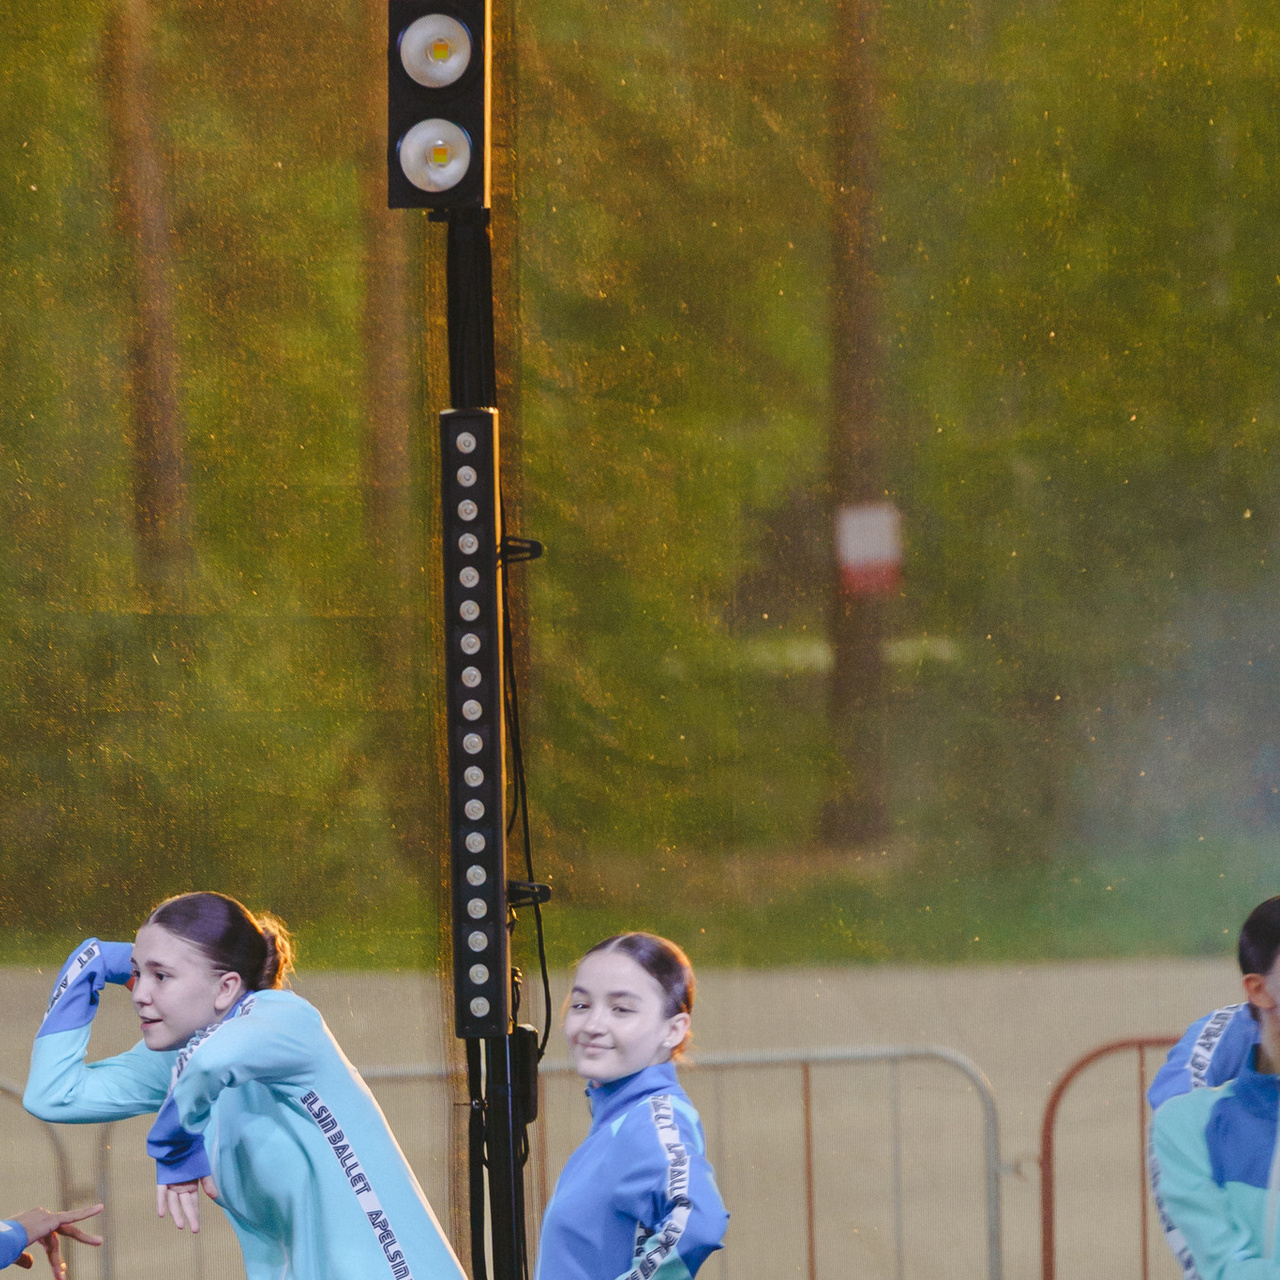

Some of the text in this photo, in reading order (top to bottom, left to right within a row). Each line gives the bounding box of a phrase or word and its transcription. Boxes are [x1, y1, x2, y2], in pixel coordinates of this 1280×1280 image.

[300, 1091, 338, 1134] ELSIN
[327, 1130, 371, 1196] BALLET
[367, 1209, 411, 1280] APELSIN
